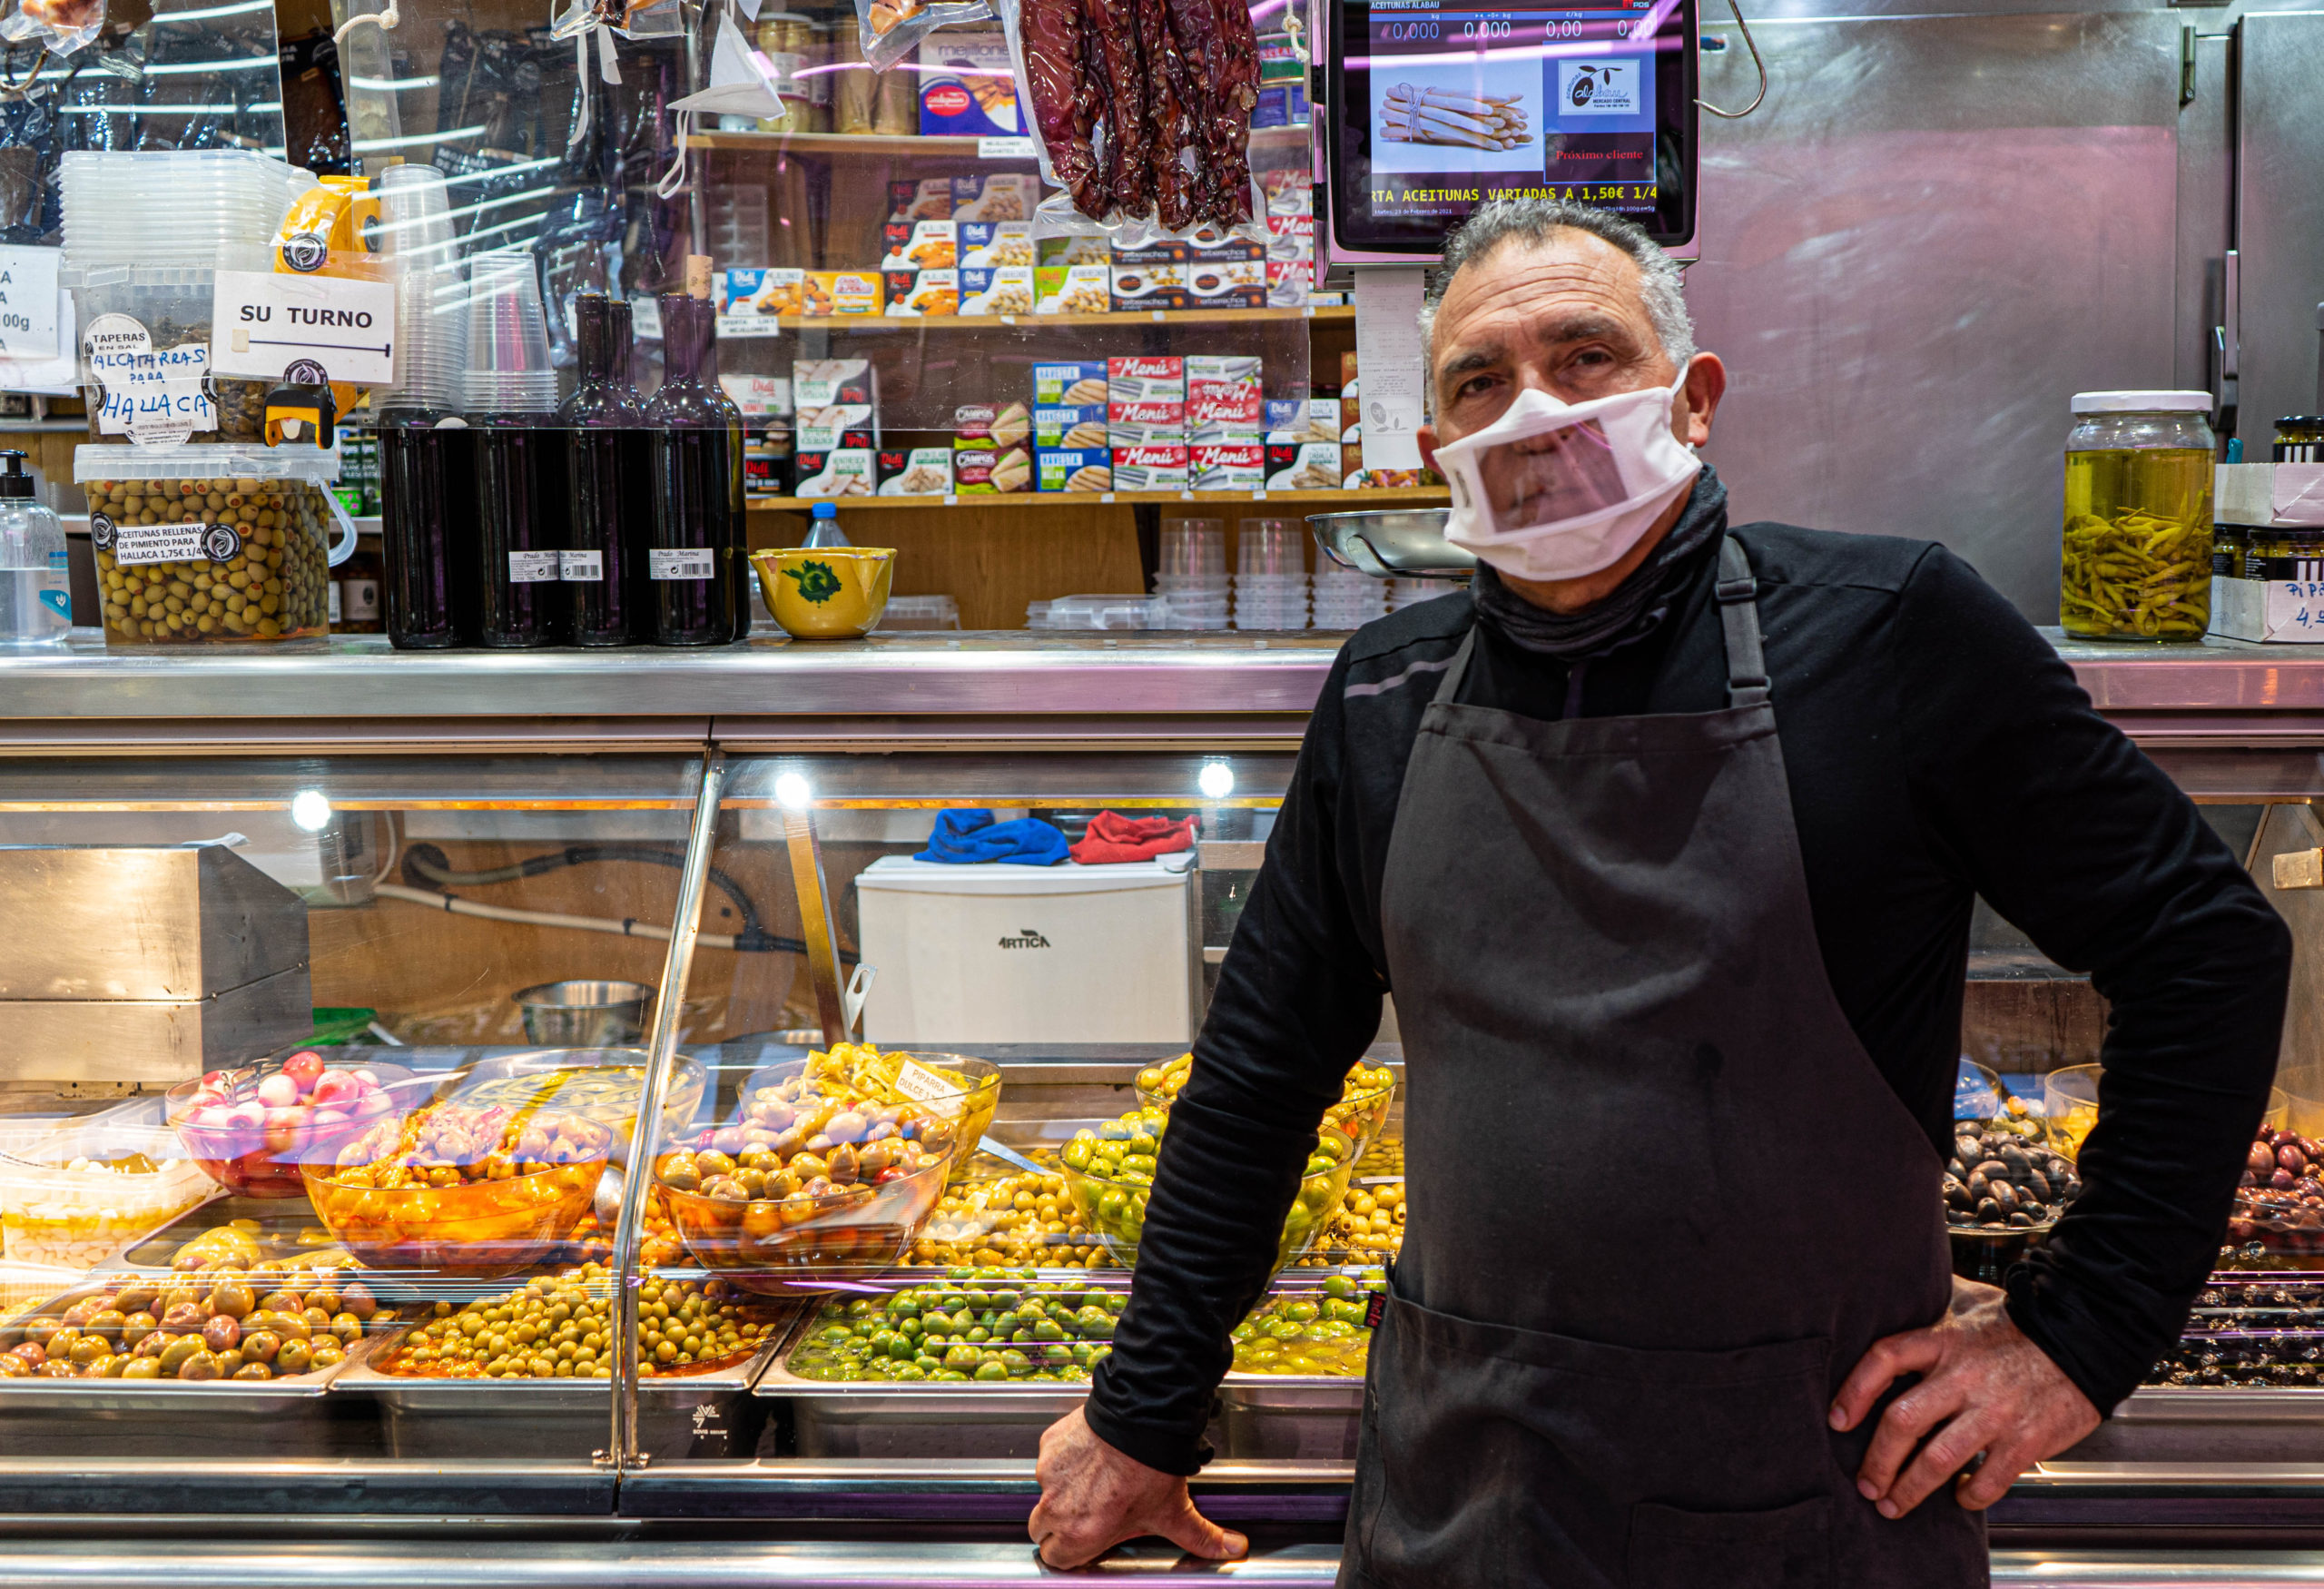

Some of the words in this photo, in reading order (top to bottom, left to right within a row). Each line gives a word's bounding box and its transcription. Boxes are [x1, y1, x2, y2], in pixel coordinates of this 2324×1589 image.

[1393, 23, 1439, 42] 0,000
[1464, 22, 1511, 40] 0,000
[1546, 21, 1582, 39] 0,00
[1618, 20, 1653, 37] 0,00
[938, 44, 1009, 58] mejillone
[1556, 150, 1604, 161] Próximo
[1606, 150, 1644, 160] cliente
[1403, 189, 1480, 202] ACEITUNAS
[1488, 187, 1556, 201] VARIADAS
[1565, 187, 1574, 200] A
[1582, 186, 1625, 202] 1,50€
[886, 225, 909, 236] Didi
[966, 225, 988, 236] Didi
[889, 272, 911, 285] Didi
[964, 271, 987, 281] Didi
[0, 313, 30, 332] 00g
[241, 305, 271, 322] SU
[287, 307, 373, 329] TURNO
[93, 332, 146, 343] TAPERAS
[1119, 358, 1170, 378] Menú
[130, 370, 166, 385] PARA
[752, 379, 775, 393] Didi
[103, 392, 209, 421] HALLACA
[1271, 403, 1293, 413] Didi
[955, 409, 995, 420] CAMPOS
[798, 454, 822, 466] Didi
[881, 452, 903, 465] Didi
[956, 453, 996, 466] CAMPOS
[1124, 447, 1175, 468] Menú
[1201, 446, 1252, 465] Menú
[1271, 447, 1294, 459] Didi
[746, 461, 769, 474] Didi
[118, 528, 161, 539] ACEITUNAS
[162, 527, 202, 537] RELLENAS
[119, 541, 130, 549] DE
[131, 539, 171, 548] PIMIENTO
[172, 538, 195, 546] PARA
[120, 551, 158, 560] HALLACA
[161, 549, 184, 559] 1,75€
[186, 548, 202, 557] 1/4
[999, 935, 1051, 949] ARTICA
[899, 1078, 923, 1096] DULCE
[912, 1070, 945, 1093] PIPARRA
